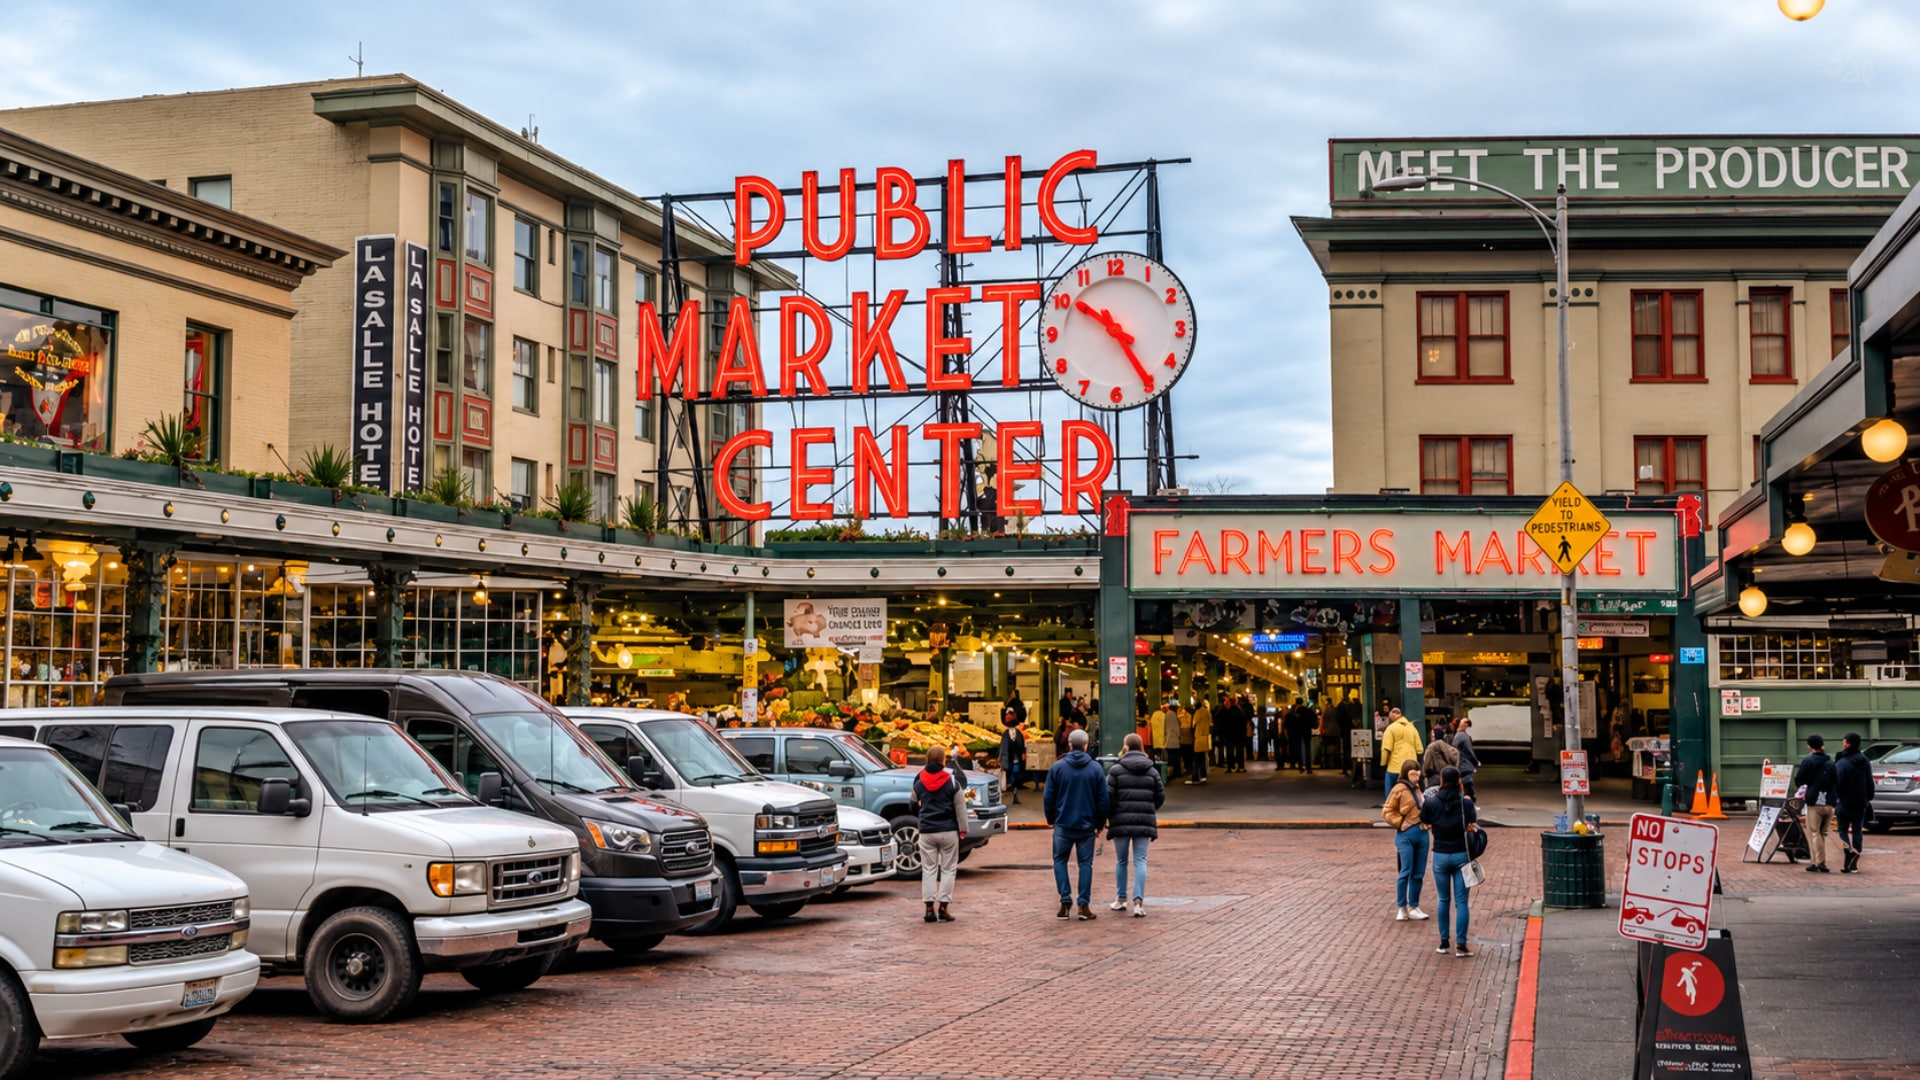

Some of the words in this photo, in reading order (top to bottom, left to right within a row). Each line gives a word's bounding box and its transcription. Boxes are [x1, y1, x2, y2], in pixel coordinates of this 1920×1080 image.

[1358, 149, 1488, 192] MEET
[1523, 146, 1620, 190] THE
[1656, 145, 1911, 189] PRODUCER
[734, 149, 1098, 267] PUBLIC
[362, 245, 386, 283] LA
[409, 250, 423, 290] LA
[1107, 259, 1124, 276] 12
[1077, 269, 1090, 287] 11
[1145, 265, 1151, 282] 1
[1053, 293, 1071, 309] 10
[1165, 288, 1177, 304] 2
[1046, 326, 1058, 343] 9
[1175, 320, 1186, 338] 3
[361, 290, 386, 389] SALLE
[409, 298, 422, 393] SALLE
[637, 283, 1042, 400] MARKET
[1055, 358, 1068, 374] 8
[1164, 352, 1177, 369] 4
[1078, 379, 1090, 396] 7
[1110, 386, 1123, 403] 6
[359, 402, 383, 488] HOTE
[407, 405, 421, 489] HOTE
[713, 419, 1114, 521] CENTER
[1552, 497, 1581, 508] YIELD
[1560, 510, 1573, 520] TO
[1531, 521, 1601, 534] PEDESTRIANS
[1152, 528, 1396, 575] FARMERS
[1434, 529, 1657, 576] MARET
[1636, 819, 1661, 839] NO
[1637, 847, 1705, 875] STOPS
